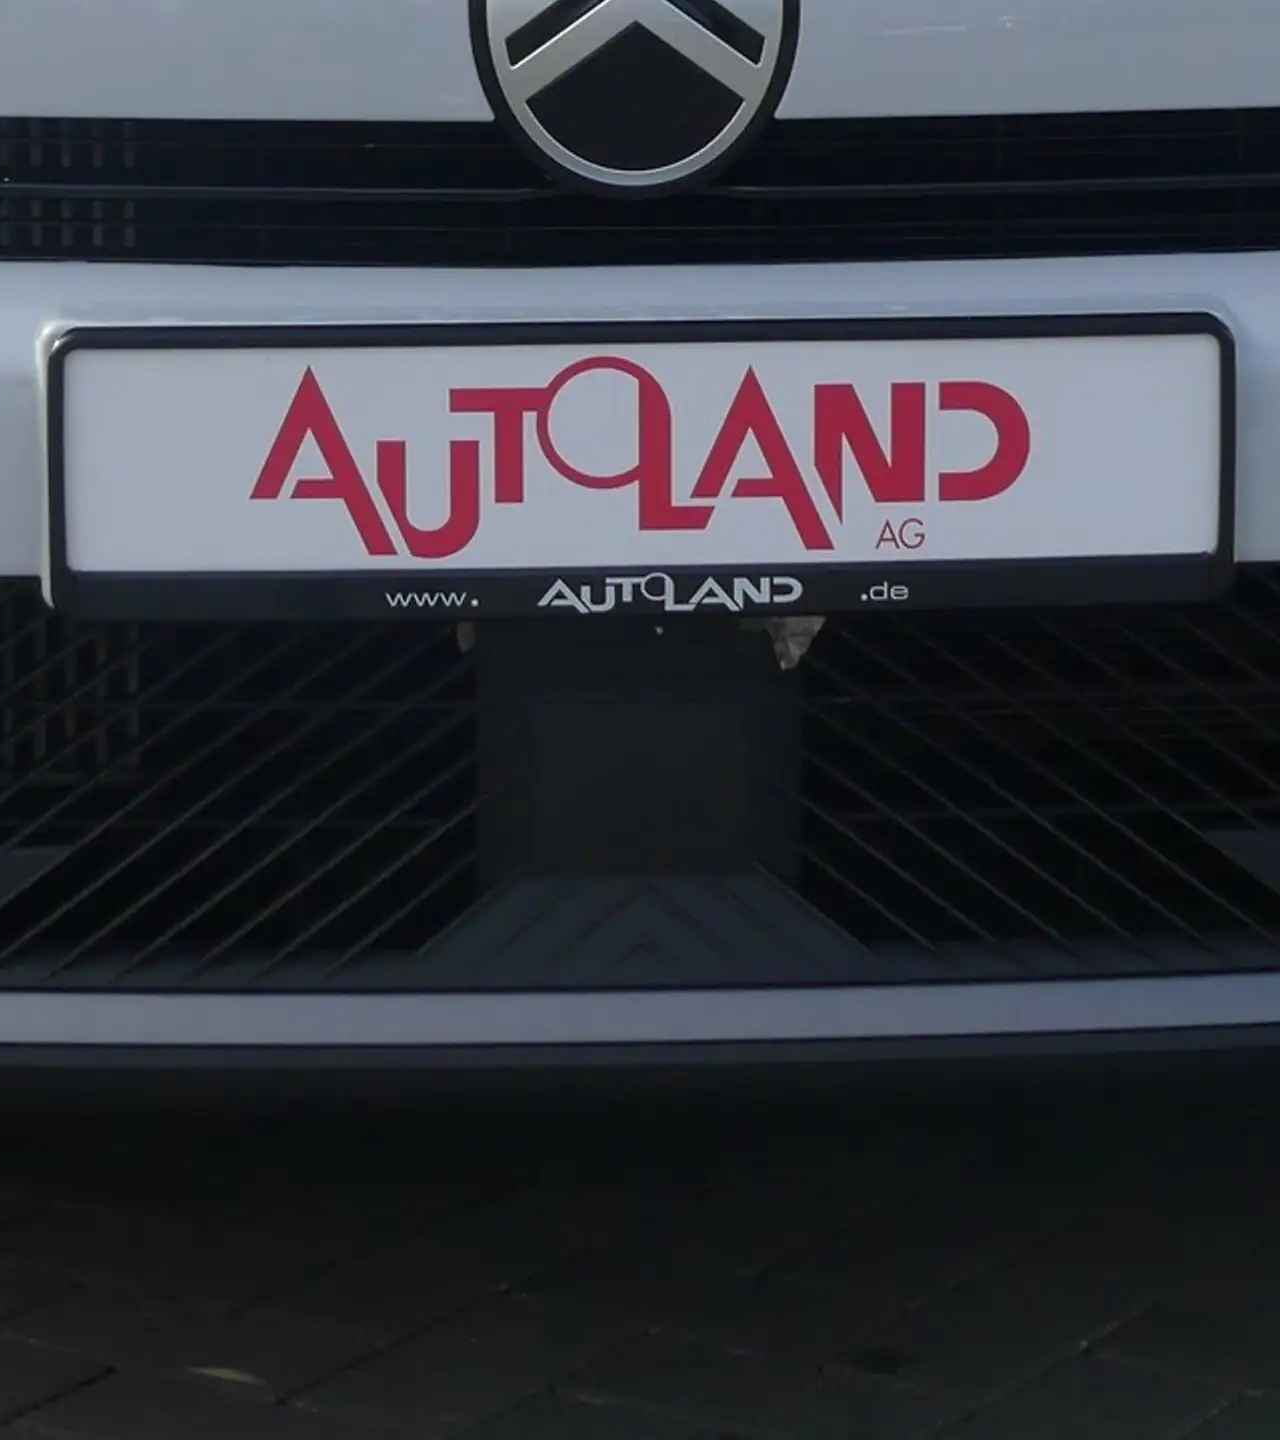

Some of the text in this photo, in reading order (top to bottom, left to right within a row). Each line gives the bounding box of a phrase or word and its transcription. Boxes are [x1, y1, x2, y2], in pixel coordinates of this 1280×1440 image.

[875, 519, 926, 550] AG
[385, 591, 479, 607] www.
[860, 581, 909, 601] .de
